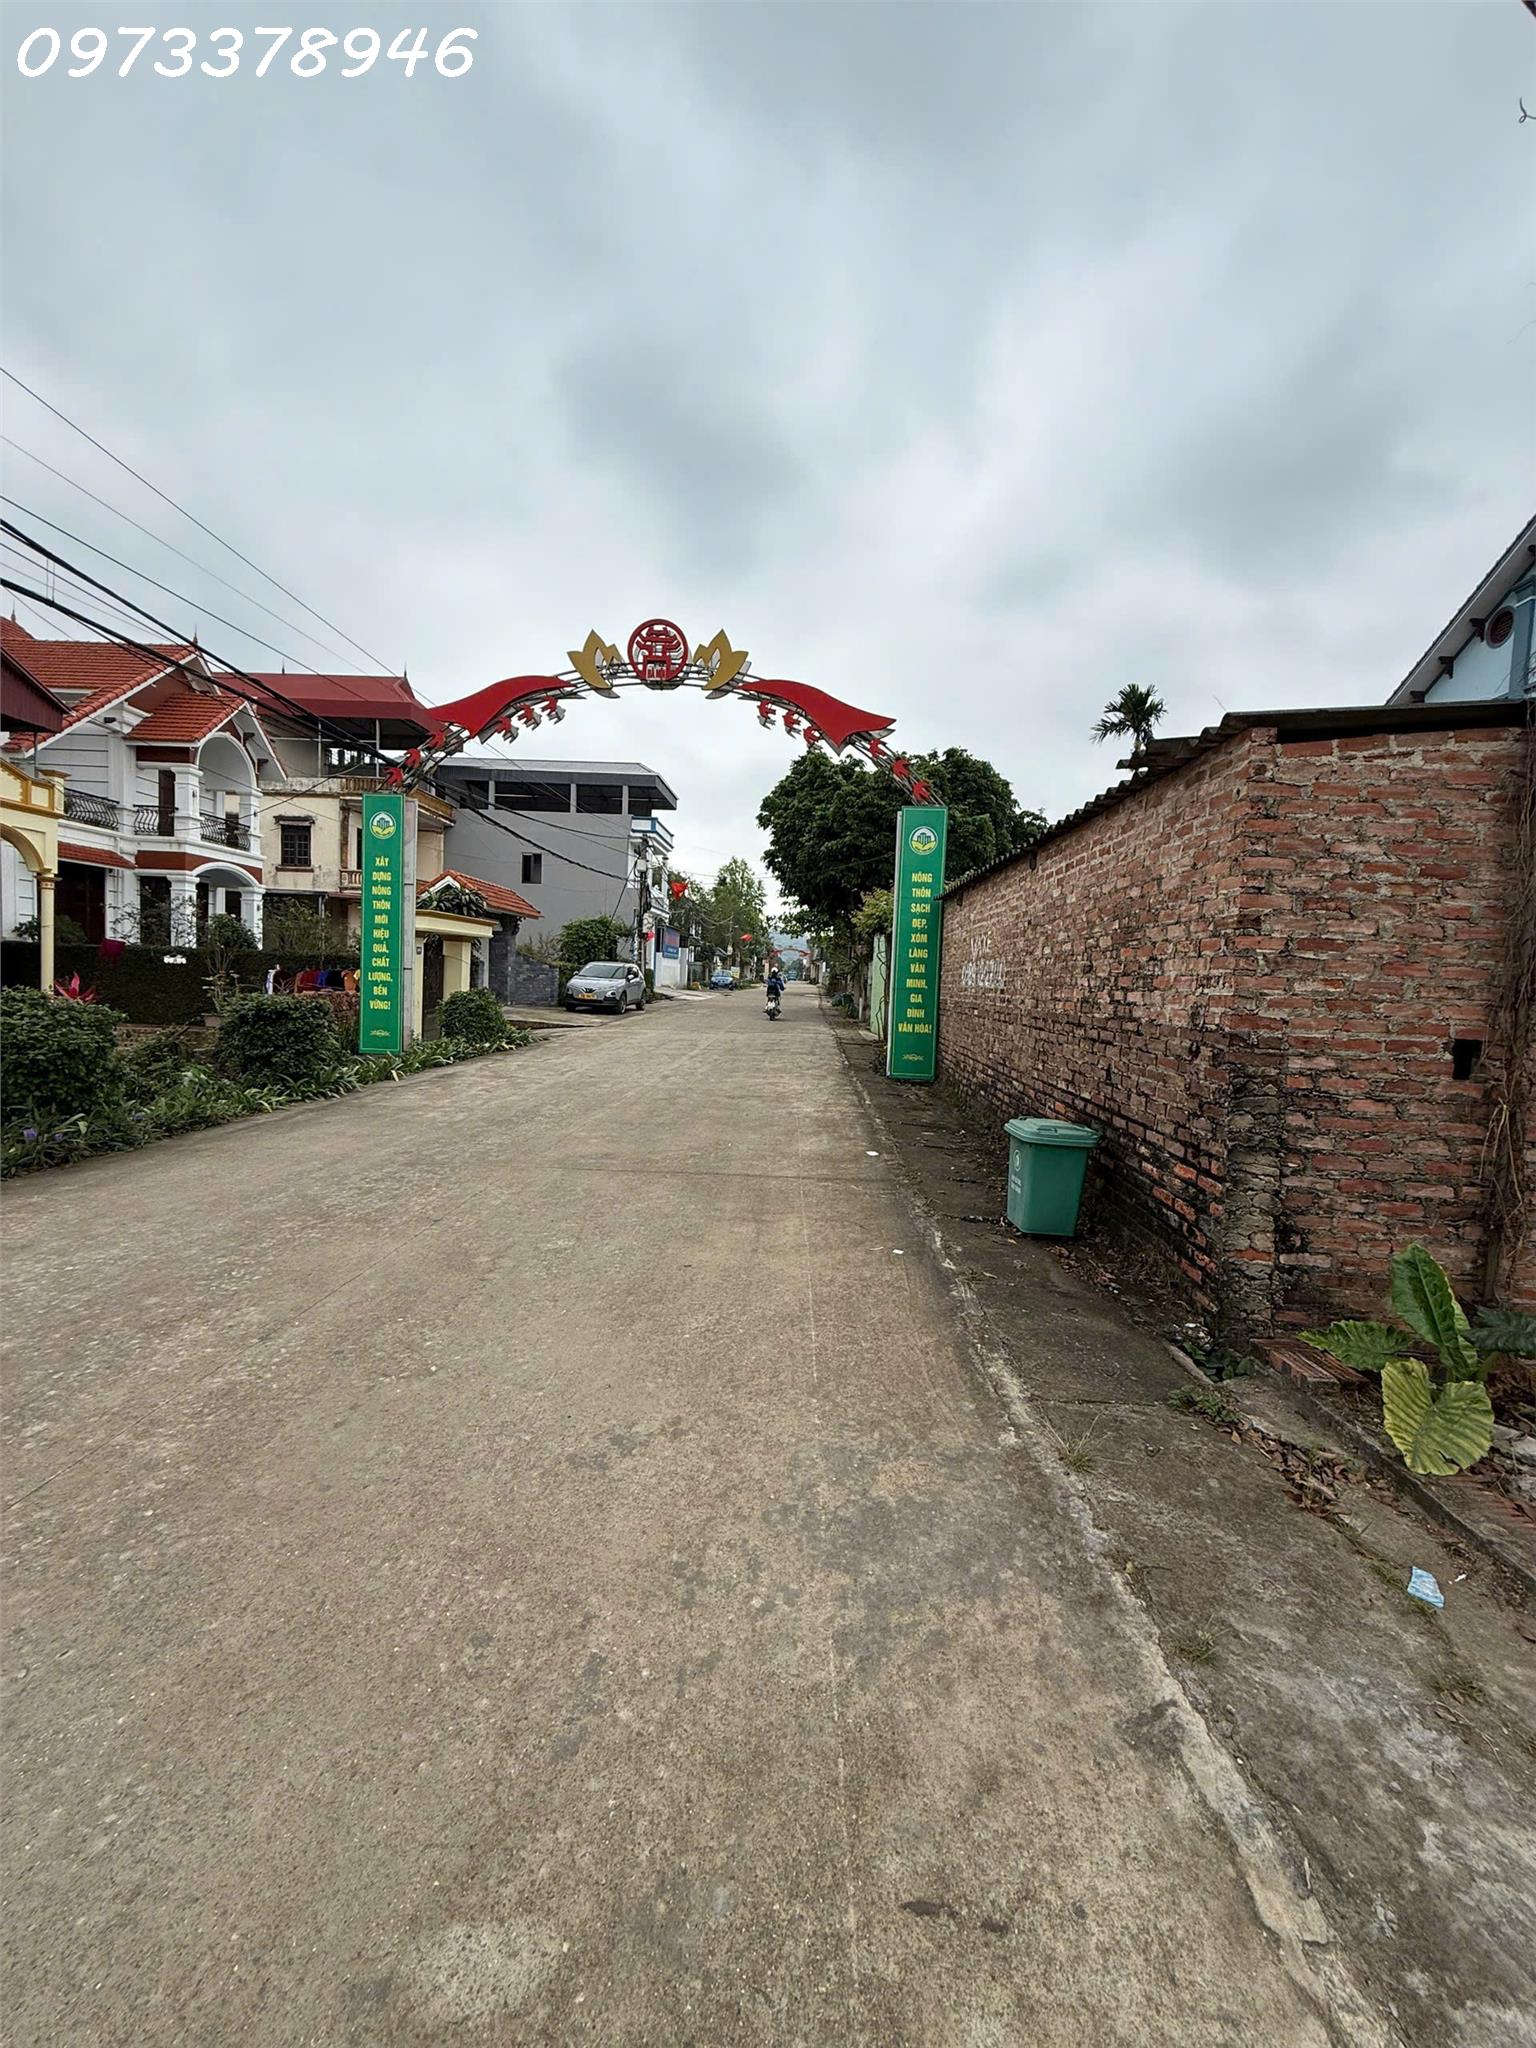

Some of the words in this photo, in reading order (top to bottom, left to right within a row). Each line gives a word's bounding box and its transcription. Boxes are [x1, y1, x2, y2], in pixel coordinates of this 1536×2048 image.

[372, 871, 392, 882] DỰNG
[911, 871, 933, 883] NÔNG
[371, 884, 392, 895] NÔNG
[911, 886, 931, 898] THÔN
[372, 899, 391, 910] THÔN
[910, 903, 931, 915] SẠCH
[372, 927, 389, 940] HIỆU
[910, 932, 928, 943] XÓM
[908, 946, 928, 958] LÀNG
[371, 955, 390, 967] CHẤT
[909, 993, 923, 1003] GIA
[906, 1007, 925, 1018] ĐÌNH
[898, 1021, 913, 1033] VĂN
